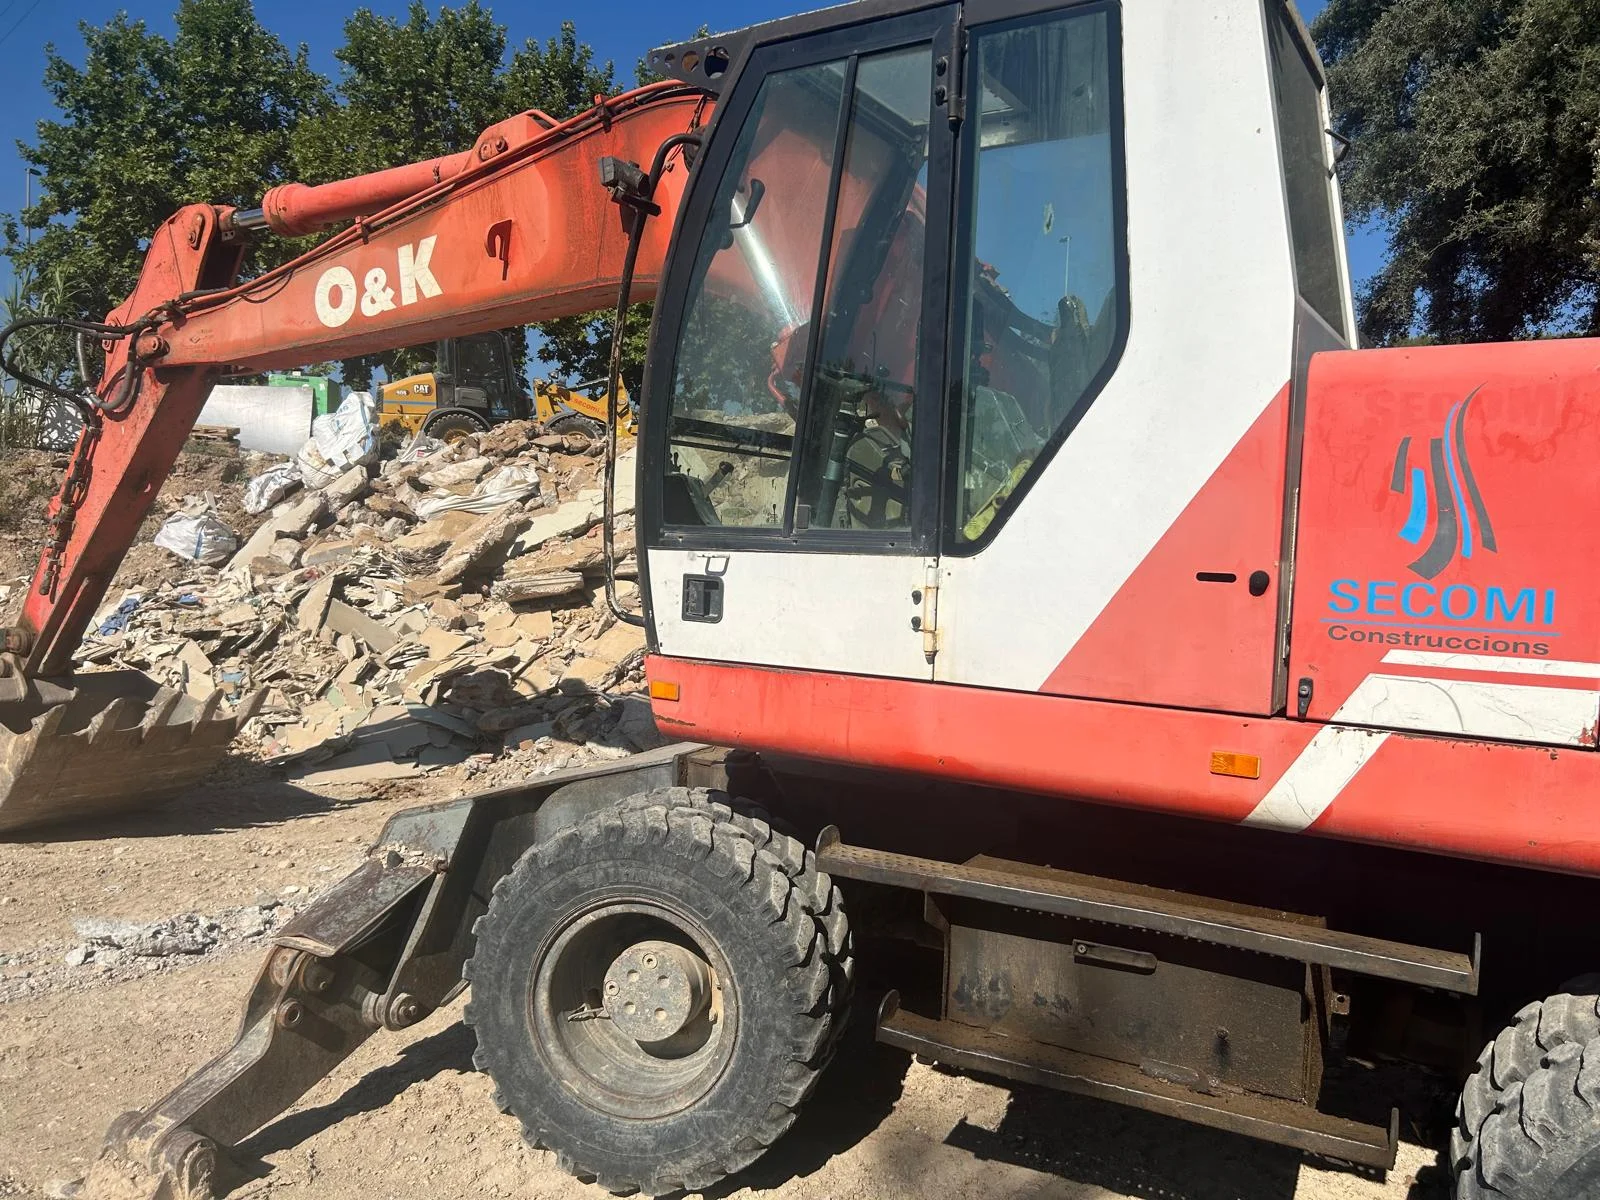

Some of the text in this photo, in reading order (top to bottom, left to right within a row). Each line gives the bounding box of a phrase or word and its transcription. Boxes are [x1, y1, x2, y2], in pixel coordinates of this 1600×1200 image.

[315, 234, 443, 328] O&K
[413, 384, 429, 394] CAT
[1327, 579, 1556, 625] SECOMI
[1328, 625, 1549, 656] Construccions
